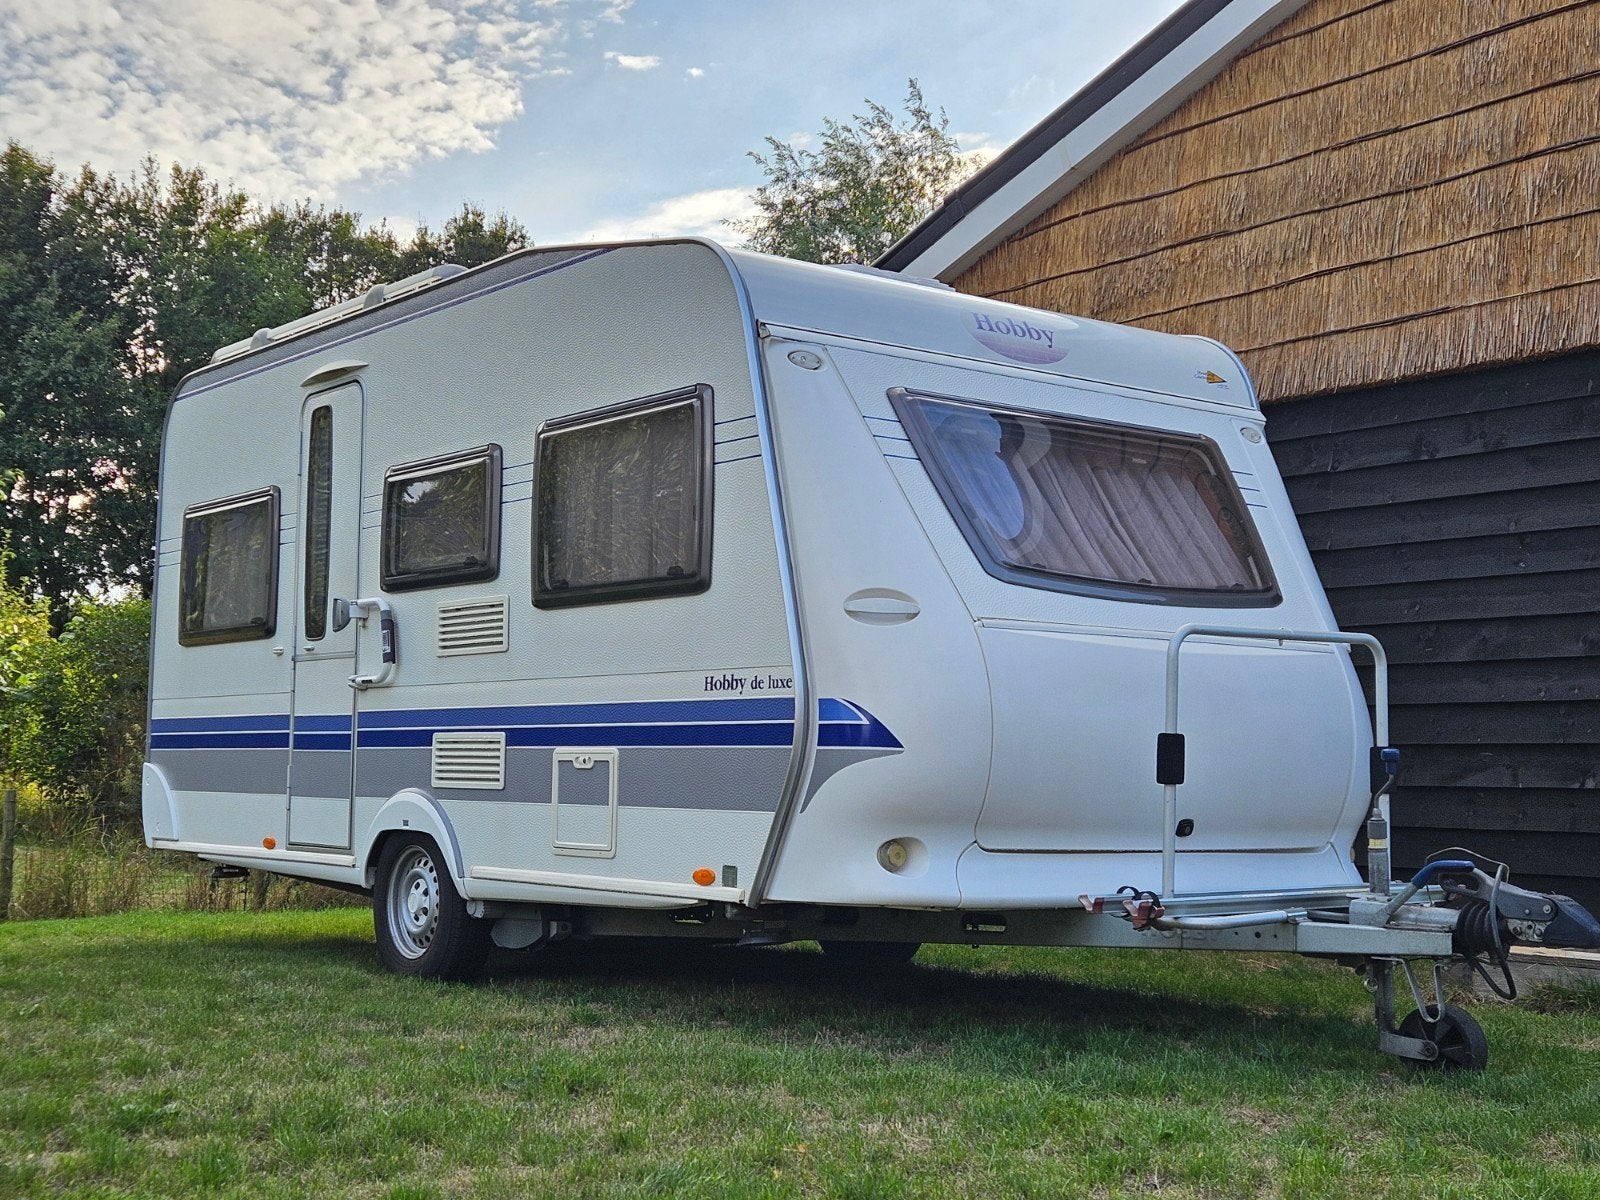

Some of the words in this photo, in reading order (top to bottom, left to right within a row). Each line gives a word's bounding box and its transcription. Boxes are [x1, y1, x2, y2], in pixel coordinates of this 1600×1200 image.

[971, 311, 1054, 349] Hobby
[704, 674, 747, 695] Hobby
[750, 675, 765, 690] de
[768, 675, 793, 689] luxe
